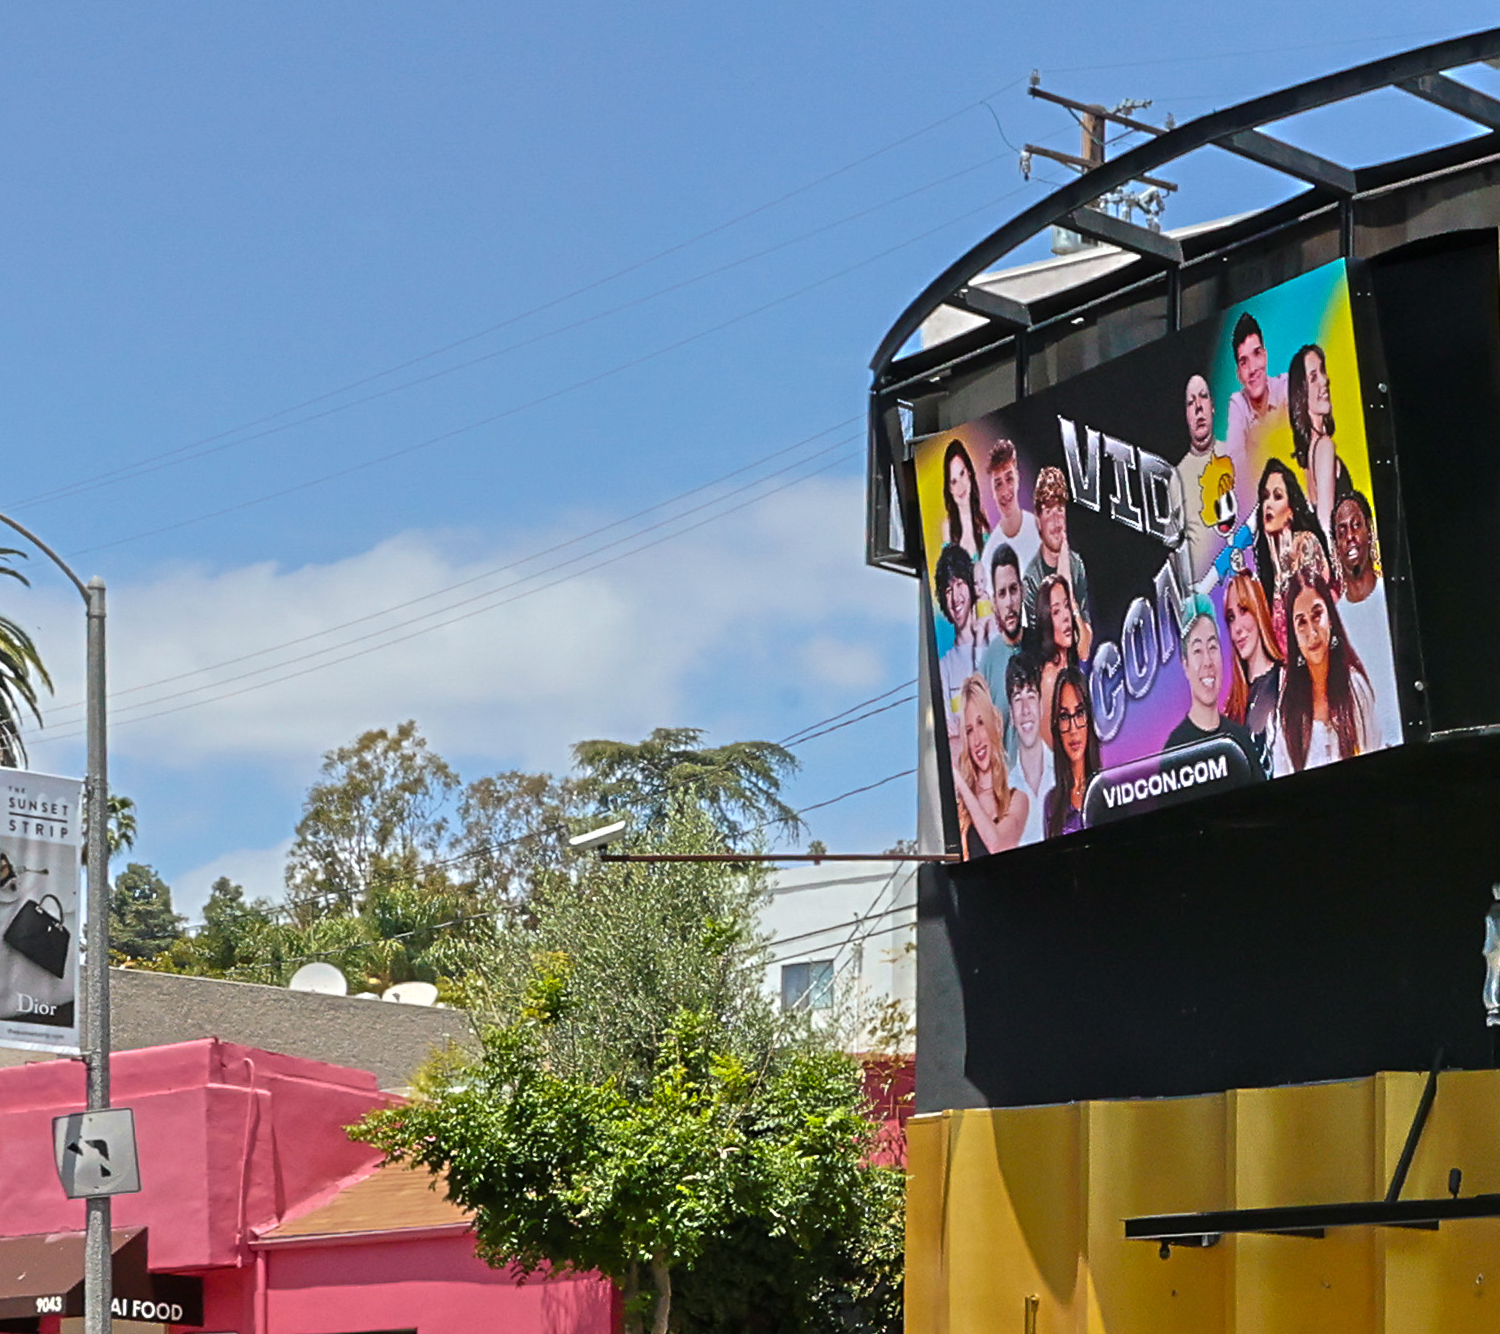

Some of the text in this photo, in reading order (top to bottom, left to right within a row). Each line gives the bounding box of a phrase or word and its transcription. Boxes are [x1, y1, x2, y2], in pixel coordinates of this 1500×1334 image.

[1057, 414, 1197, 742] VID CON
[1103, 753, 1229, 809] VIDCON.COM
[8, 797, 69, 816] SUNSET
[8, 819, 69, 838] STRIP
[16, 992, 57, 1015] Dior
[35, 1296, 62, 1313] 9043
[132, 1300, 183, 1321] FOOD
